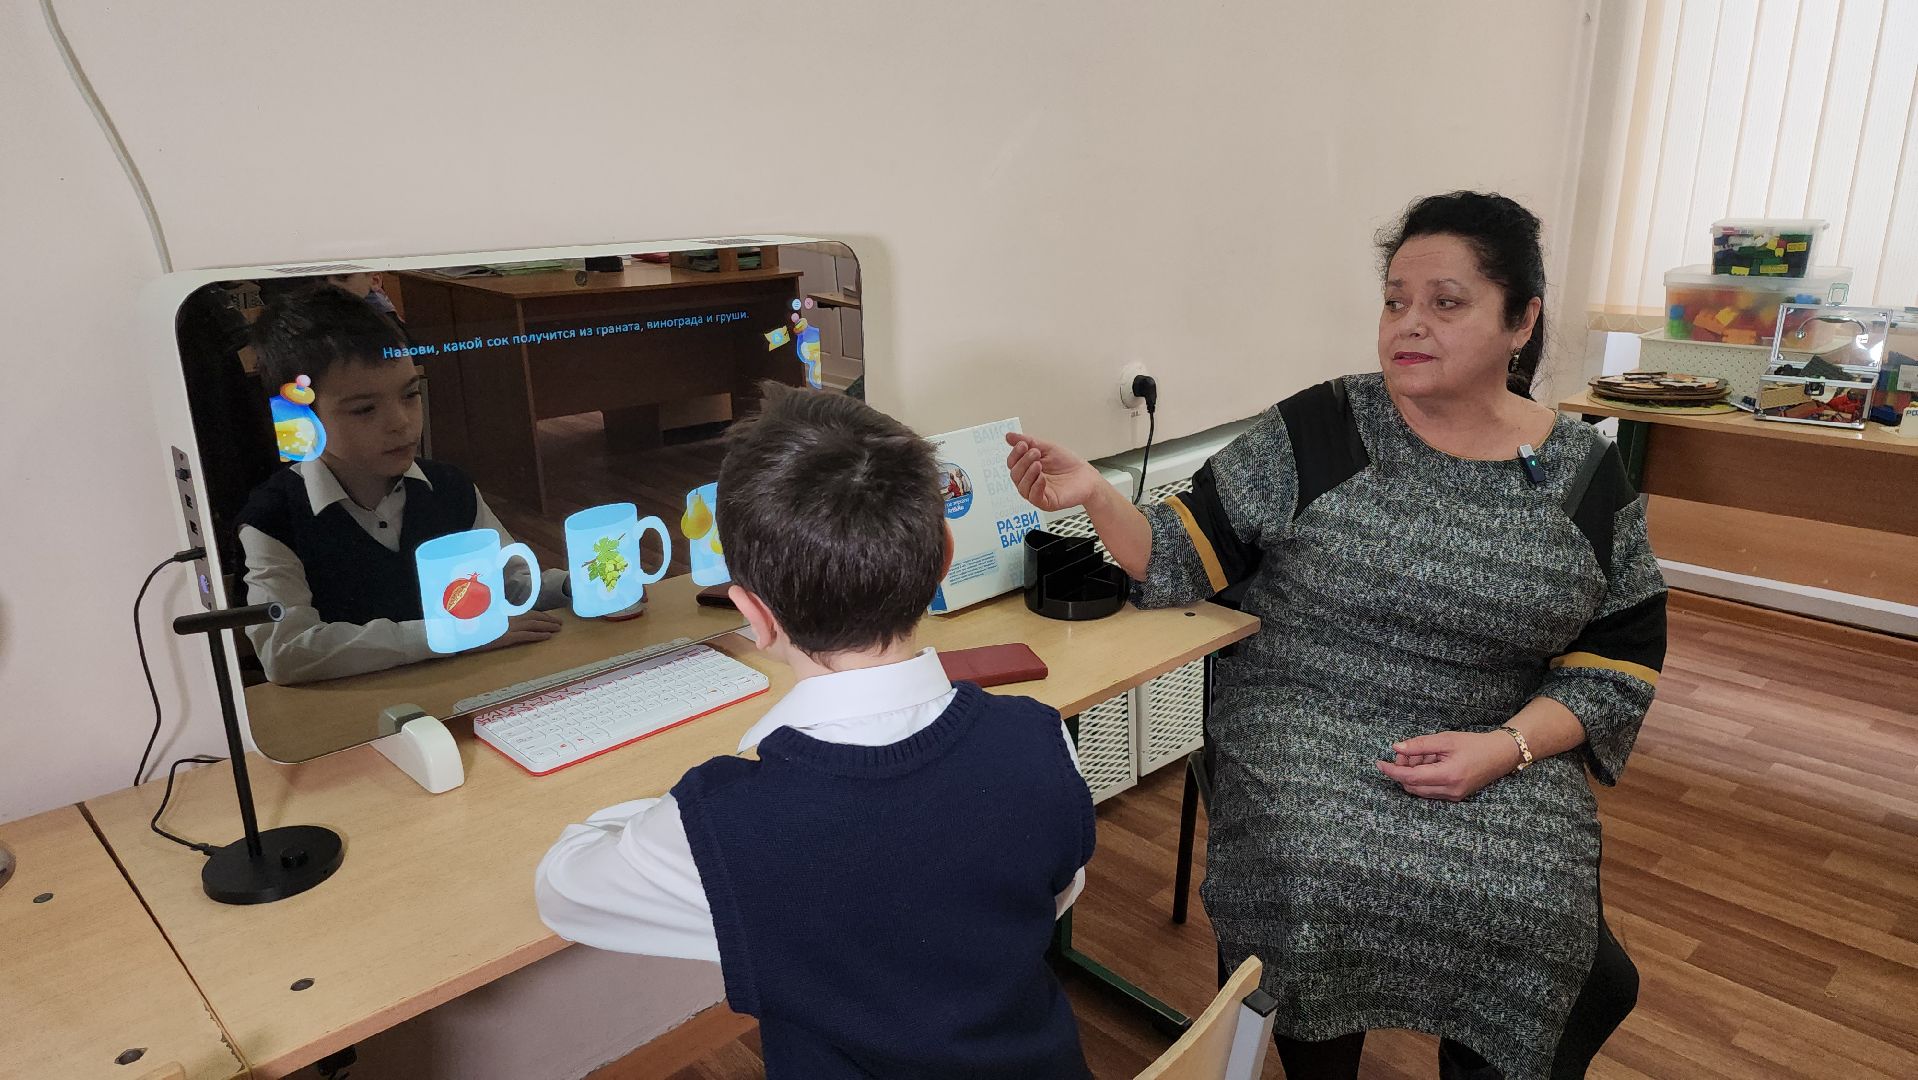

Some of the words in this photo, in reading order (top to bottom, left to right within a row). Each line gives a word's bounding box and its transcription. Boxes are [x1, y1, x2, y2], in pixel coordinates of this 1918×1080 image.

[383, 345, 440, 360] Назови,
[443, 336, 483, 353] какой
[487, 337, 510, 348] сок
[513, 329, 576, 345] получится
[580, 327, 593, 337] из
[596, 321, 645, 337] граната,
[647, 315, 704, 330] винограда
[716, 311, 750, 325] груши.
[996, 510, 1040, 535] РАЗВИ
